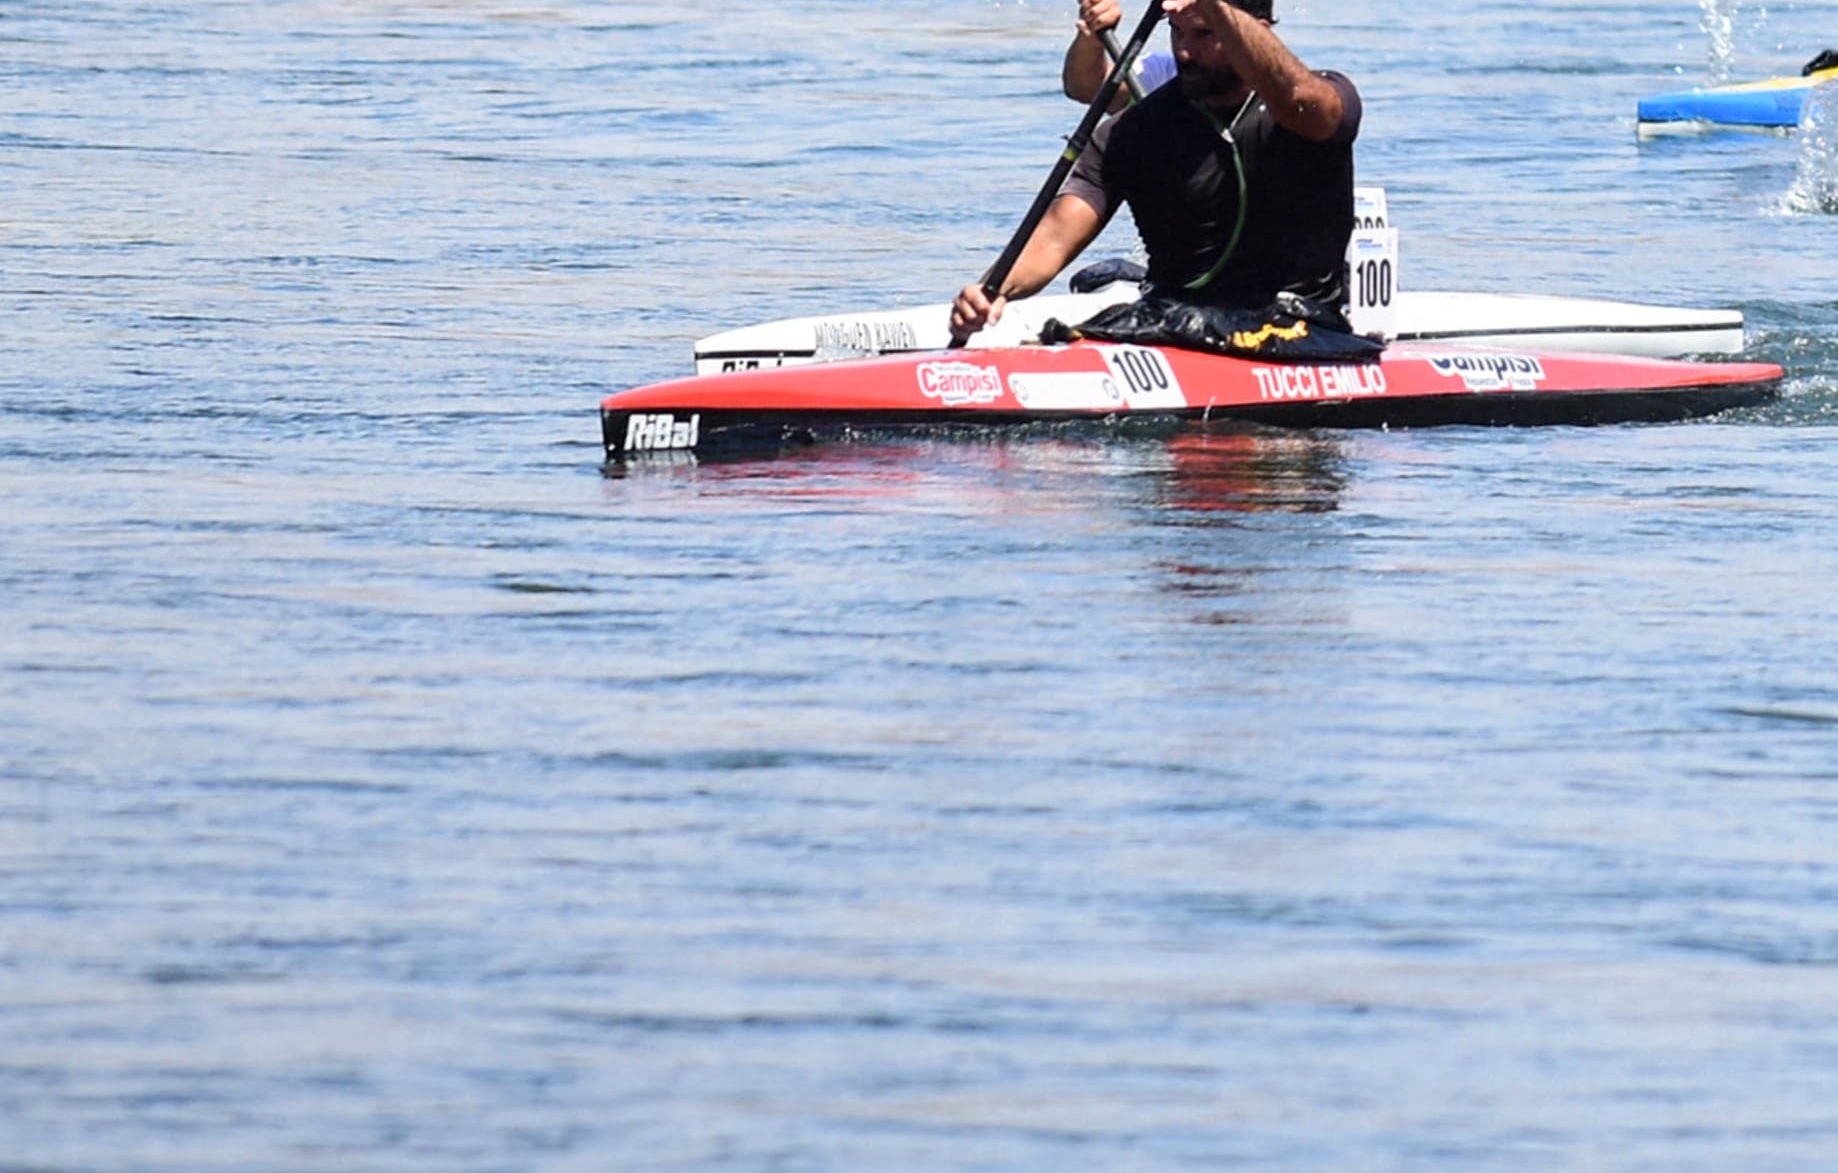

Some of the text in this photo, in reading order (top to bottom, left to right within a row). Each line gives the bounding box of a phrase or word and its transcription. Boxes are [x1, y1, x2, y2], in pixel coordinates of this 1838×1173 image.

[1356, 258, 1391, 308] 100
[921, 367, 1001, 397] Campisi
[1112, 349, 1169, 394] 100
[1251, 364, 1387, 400] TUCCI EMILIO
[623, 413, 701, 451] RiBal
